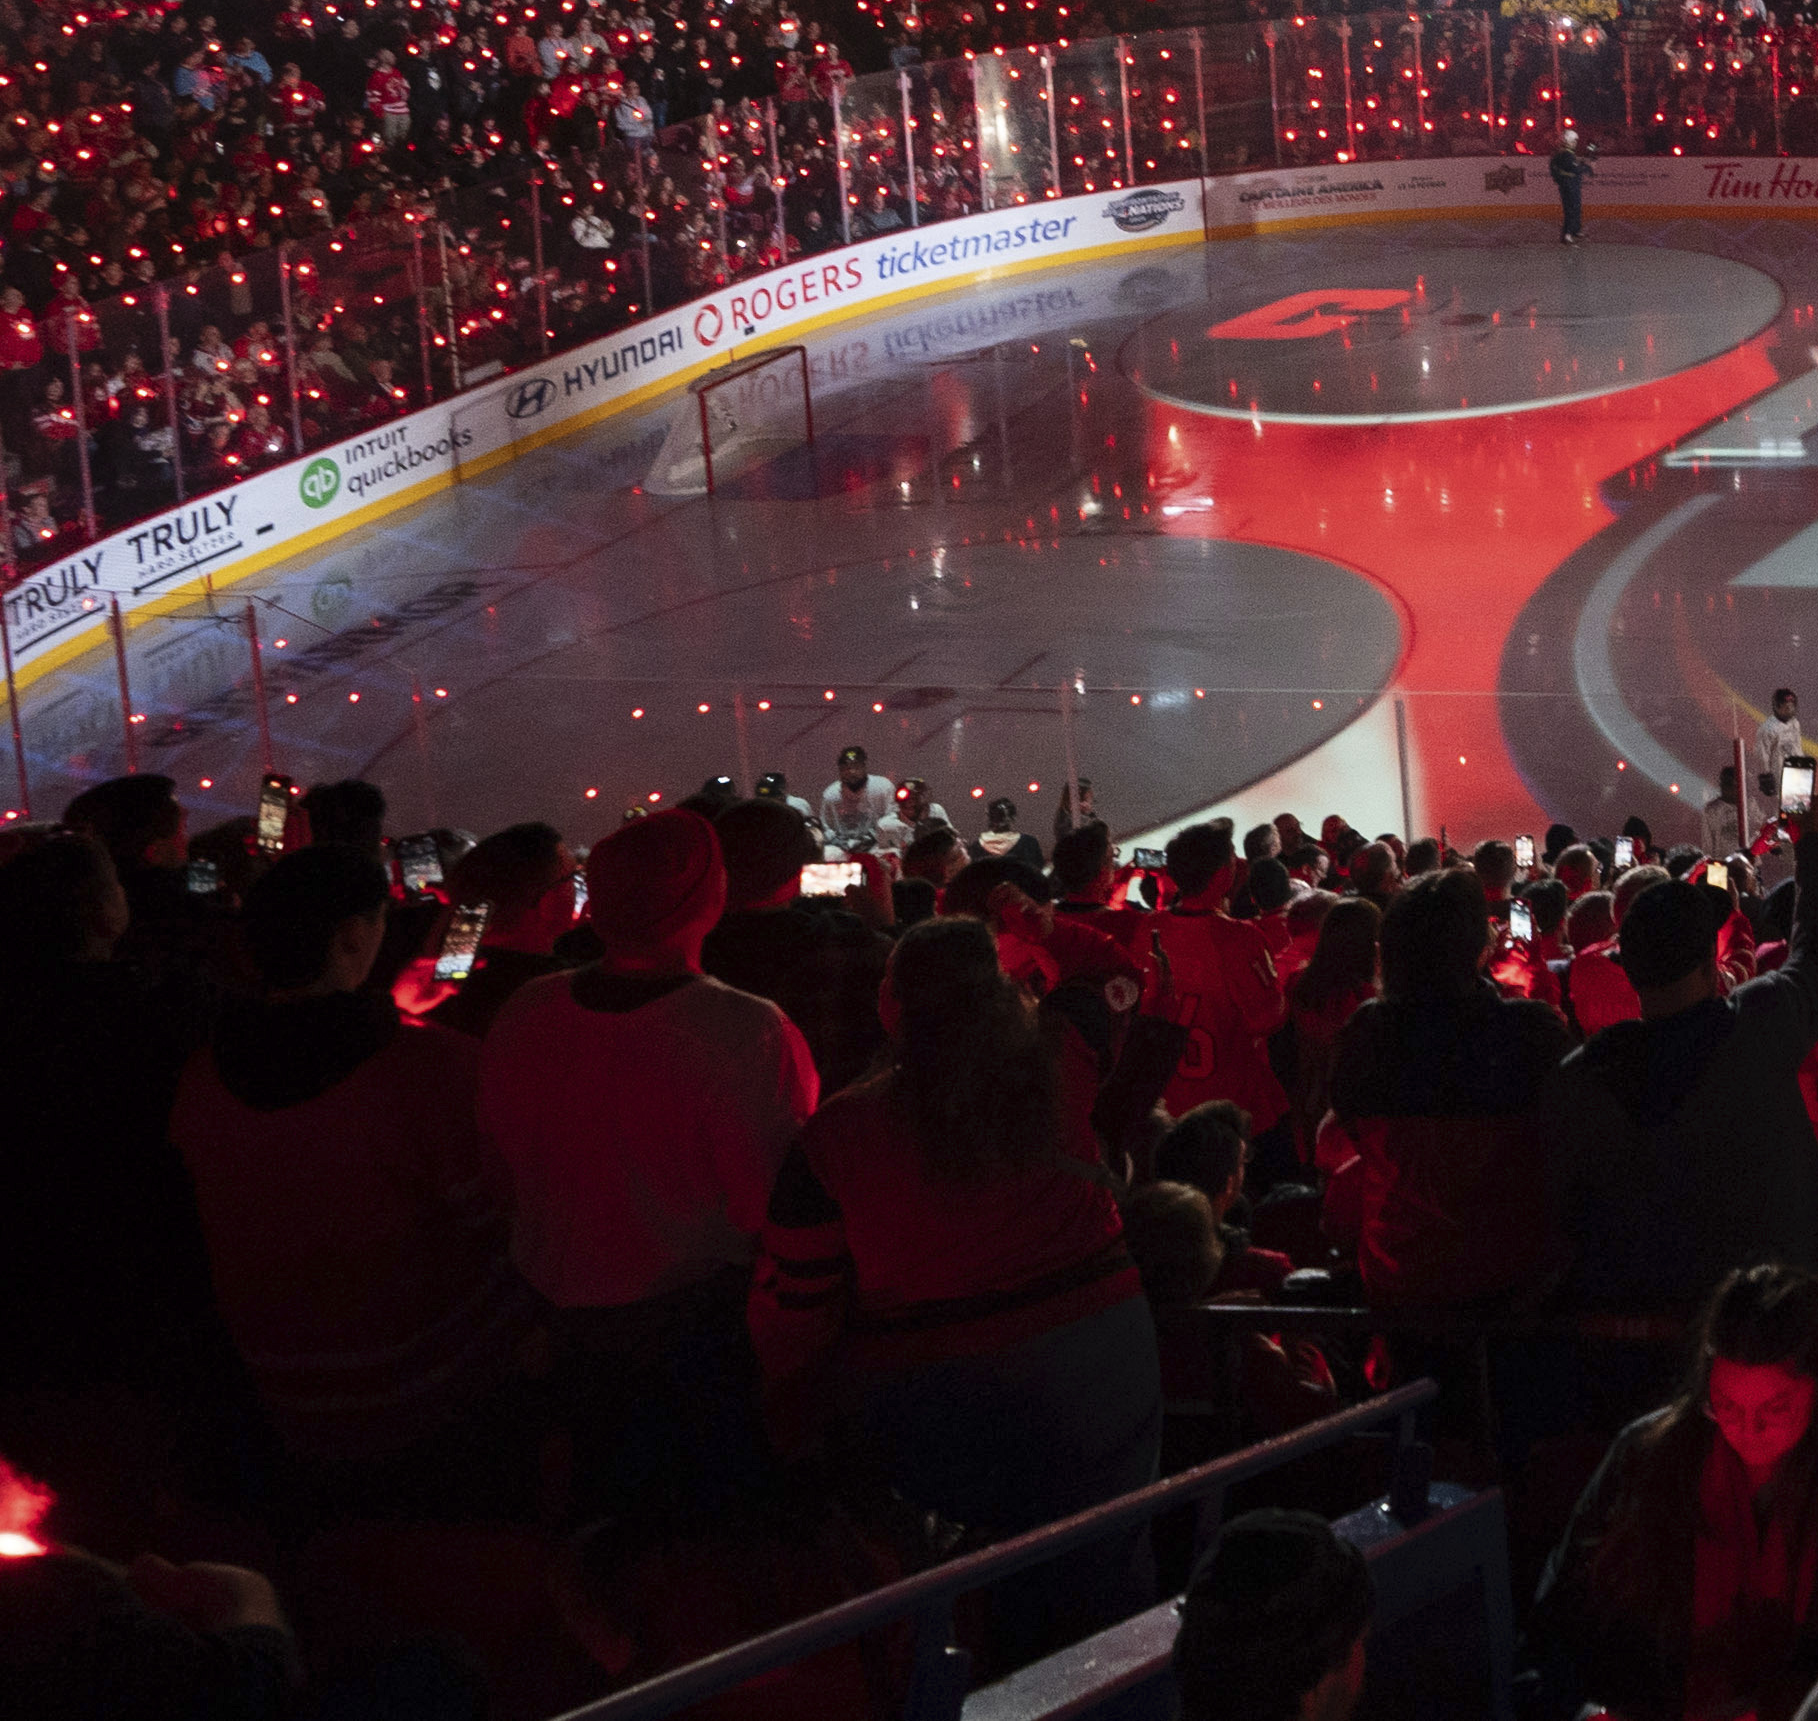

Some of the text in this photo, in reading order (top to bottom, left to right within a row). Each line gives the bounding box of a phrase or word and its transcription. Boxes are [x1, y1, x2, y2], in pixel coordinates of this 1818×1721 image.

[1703, 163, 1762, 200] Tim
[731, 210, 1077, 330] ROGERS ticketmaster
[562, 325, 684, 399] HYUNDAI
[345, 426, 408, 465] INTUIT
[346, 428, 474, 498] quickbooks
[127, 494, 238, 564] TRULY
[8, 550, 105, 626] TRULY
